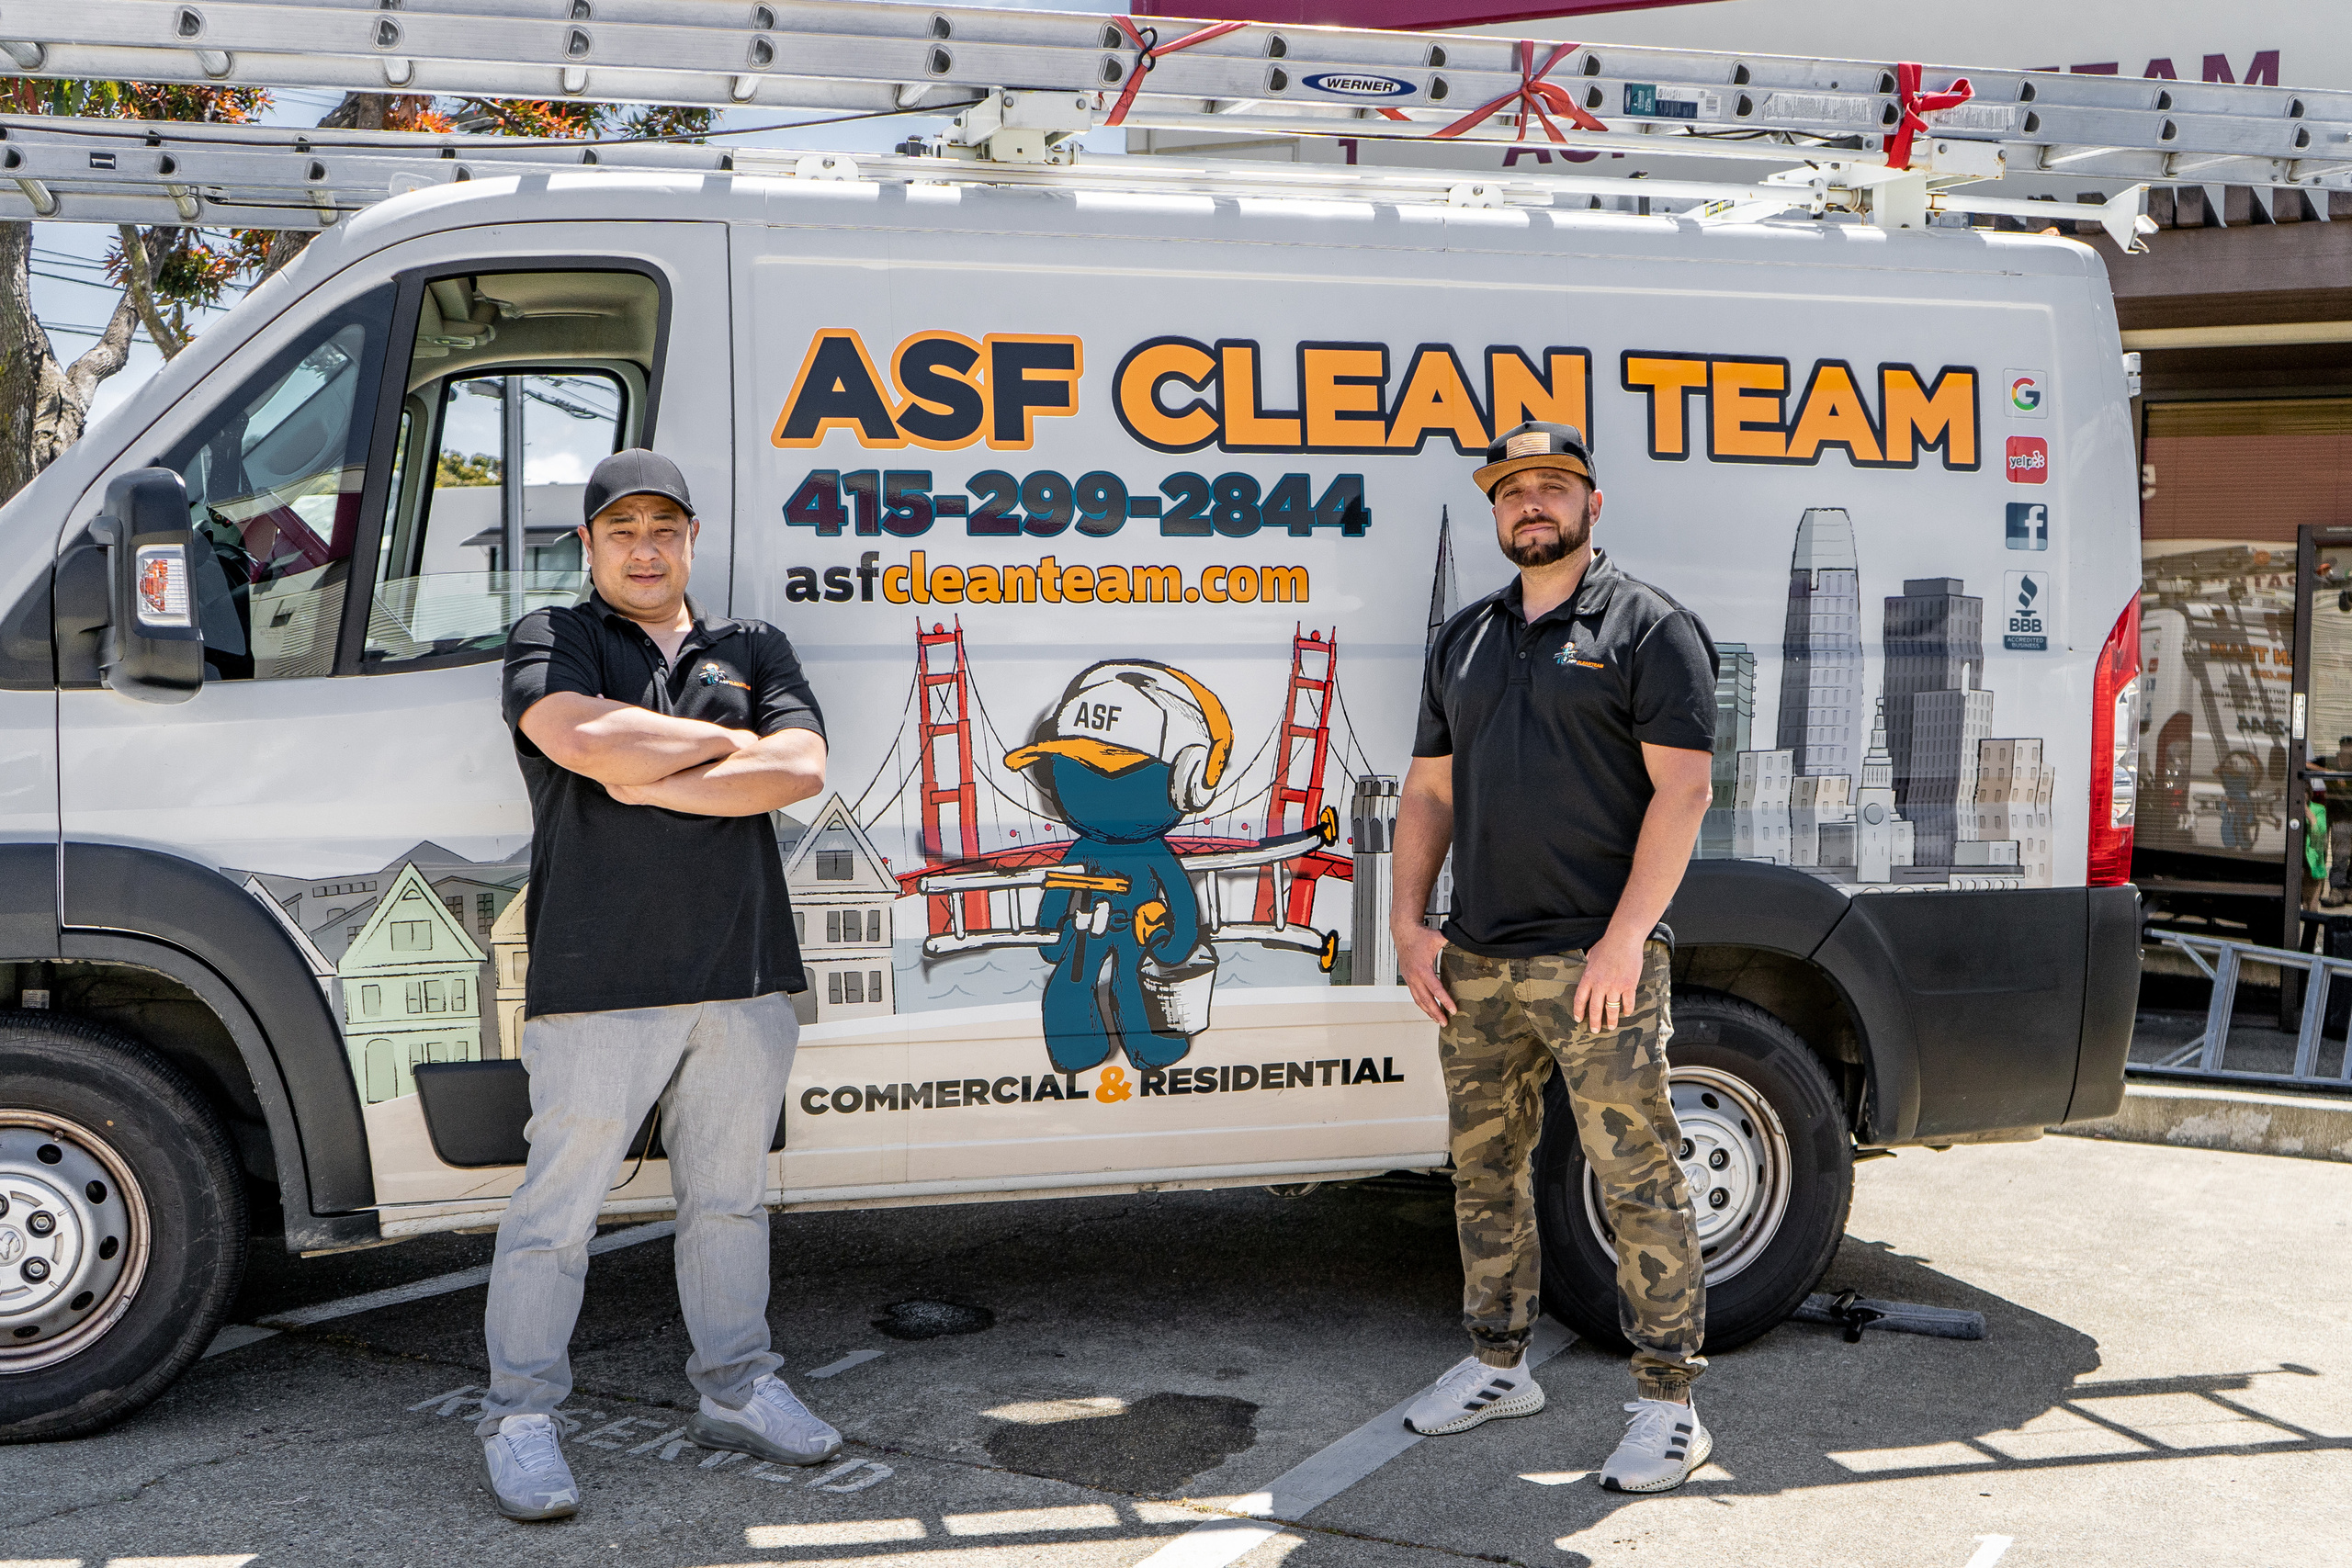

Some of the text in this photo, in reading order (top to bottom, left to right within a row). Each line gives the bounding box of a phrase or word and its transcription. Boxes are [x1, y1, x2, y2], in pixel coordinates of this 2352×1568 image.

[1327, 78, 1394, 92] WERNER
[771, 328, 1981, 471] ASF CLEAN TEAM
[2009, 454, 2033, 470] yelp
[783, 469, 1372, 537] 415-299-2844
[786, 550, 1309, 604] asfcleanteam.com
[2009, 618, 2042, 632] BBB
[1073, 702, 1122, 732] ASF
[800, 1056, 1405, 1115] COMMERCIAL & RESIDENTIAL
